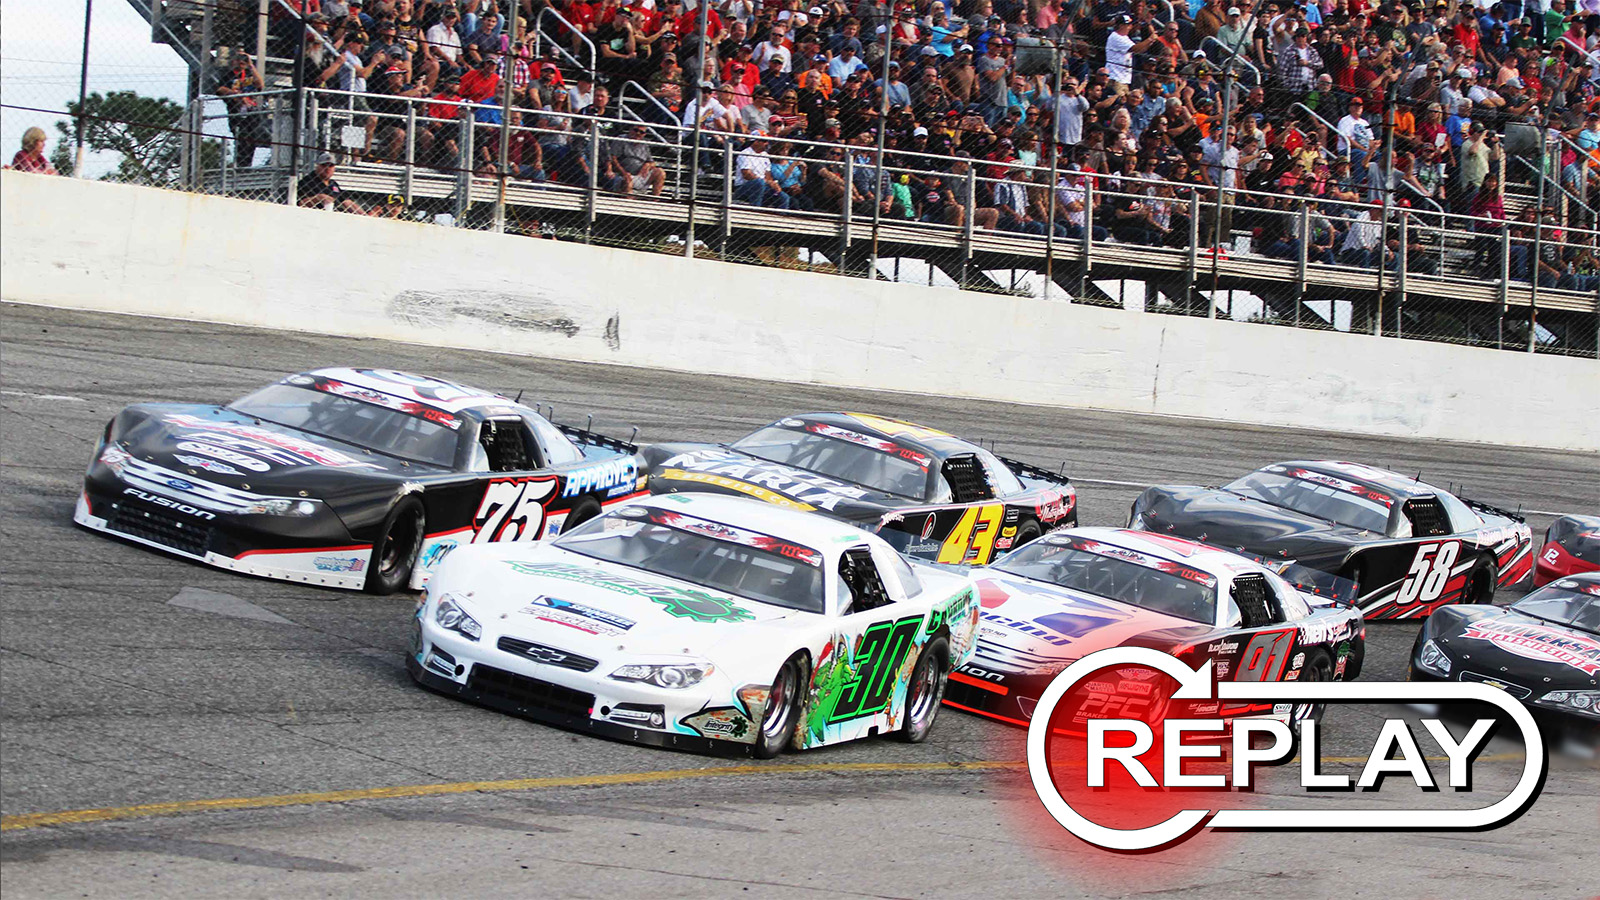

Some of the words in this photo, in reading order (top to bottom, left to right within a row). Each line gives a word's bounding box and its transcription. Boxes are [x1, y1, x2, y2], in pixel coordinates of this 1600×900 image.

[562, 456, 637, 498] APPROVED
[659, 453, 844, 511] MARIA
[682, 473, 764, 497] BREWING
[123, 487, 217, 521] FUSION
[471, 475, 560, 543] 75
[936, 504, 1005, 566] 43
[1396, 540, 1462, 606] 58
[1476, 619, 1600, 662] UNIVERSA
[828, 613, 925, 725] 30
[1079, 692, 1151, 719] PFC
